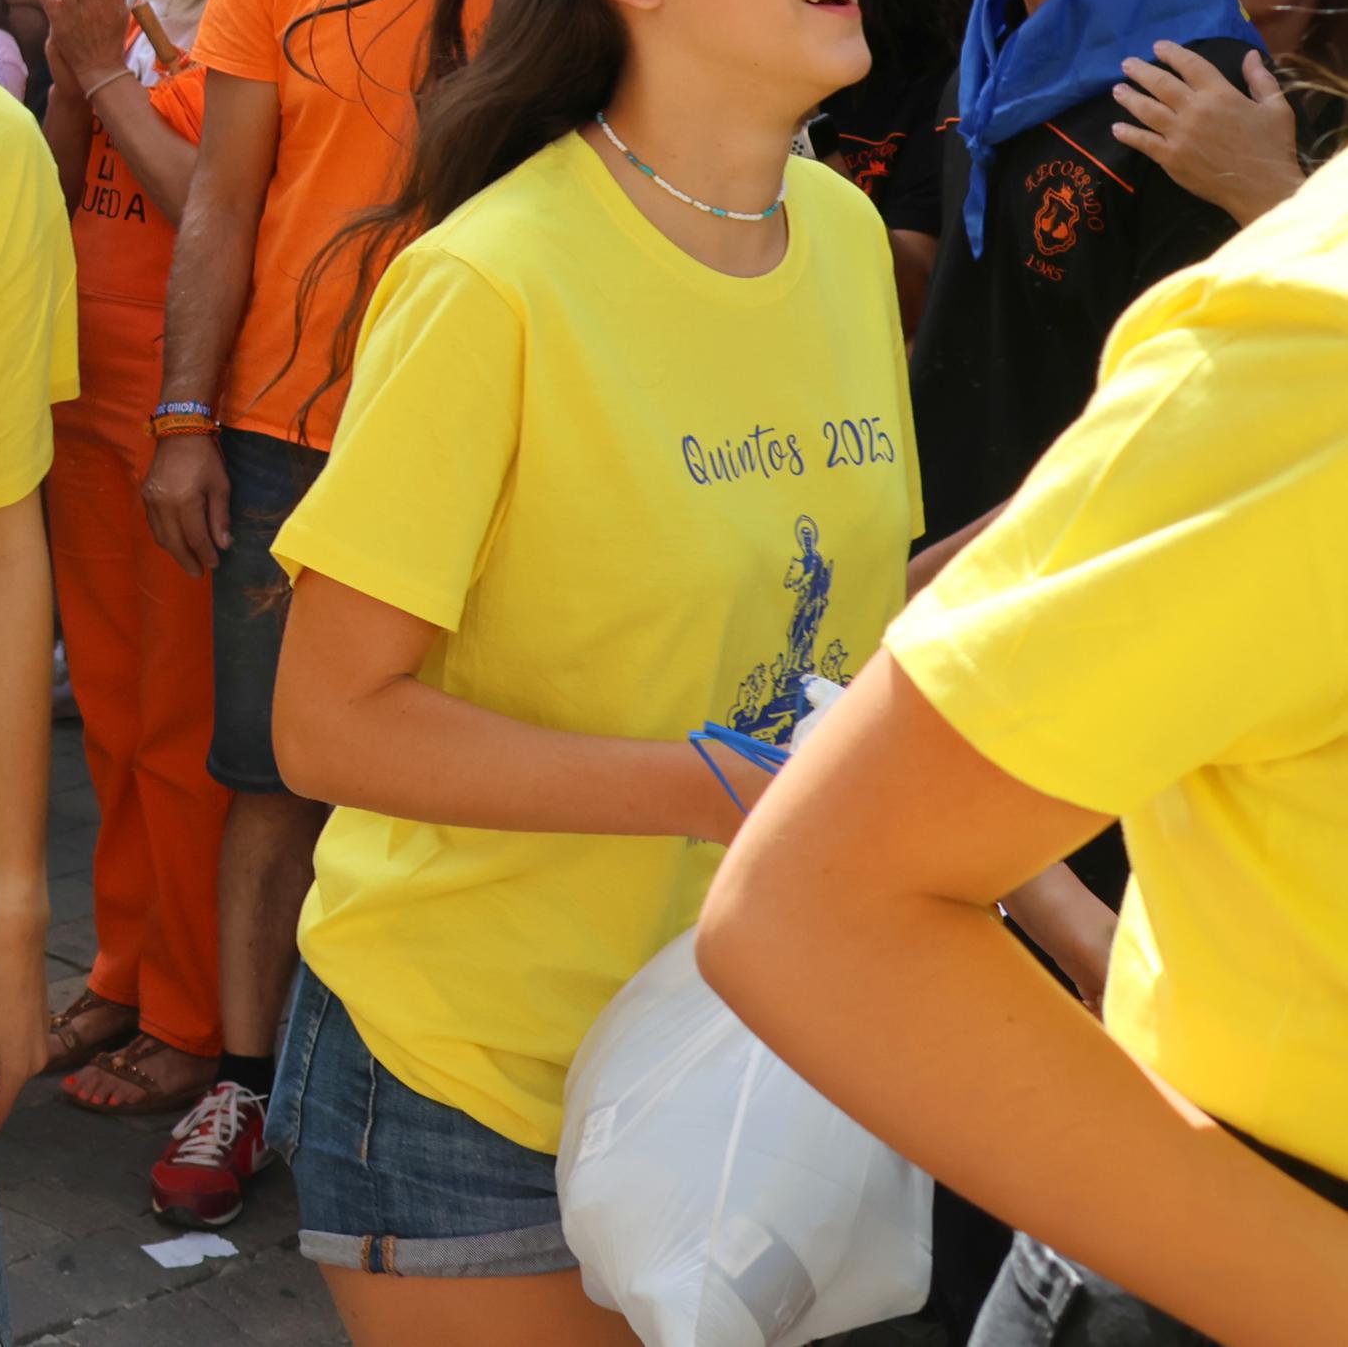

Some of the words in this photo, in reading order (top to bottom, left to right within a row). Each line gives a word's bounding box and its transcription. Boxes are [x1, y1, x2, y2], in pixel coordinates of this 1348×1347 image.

[81, 181, 146, 224] UEDA
[1024, 253, 1066, 282] 1985
[681, 424, 805, 485] Quintos
[823, 416, 895, 468] 2025
